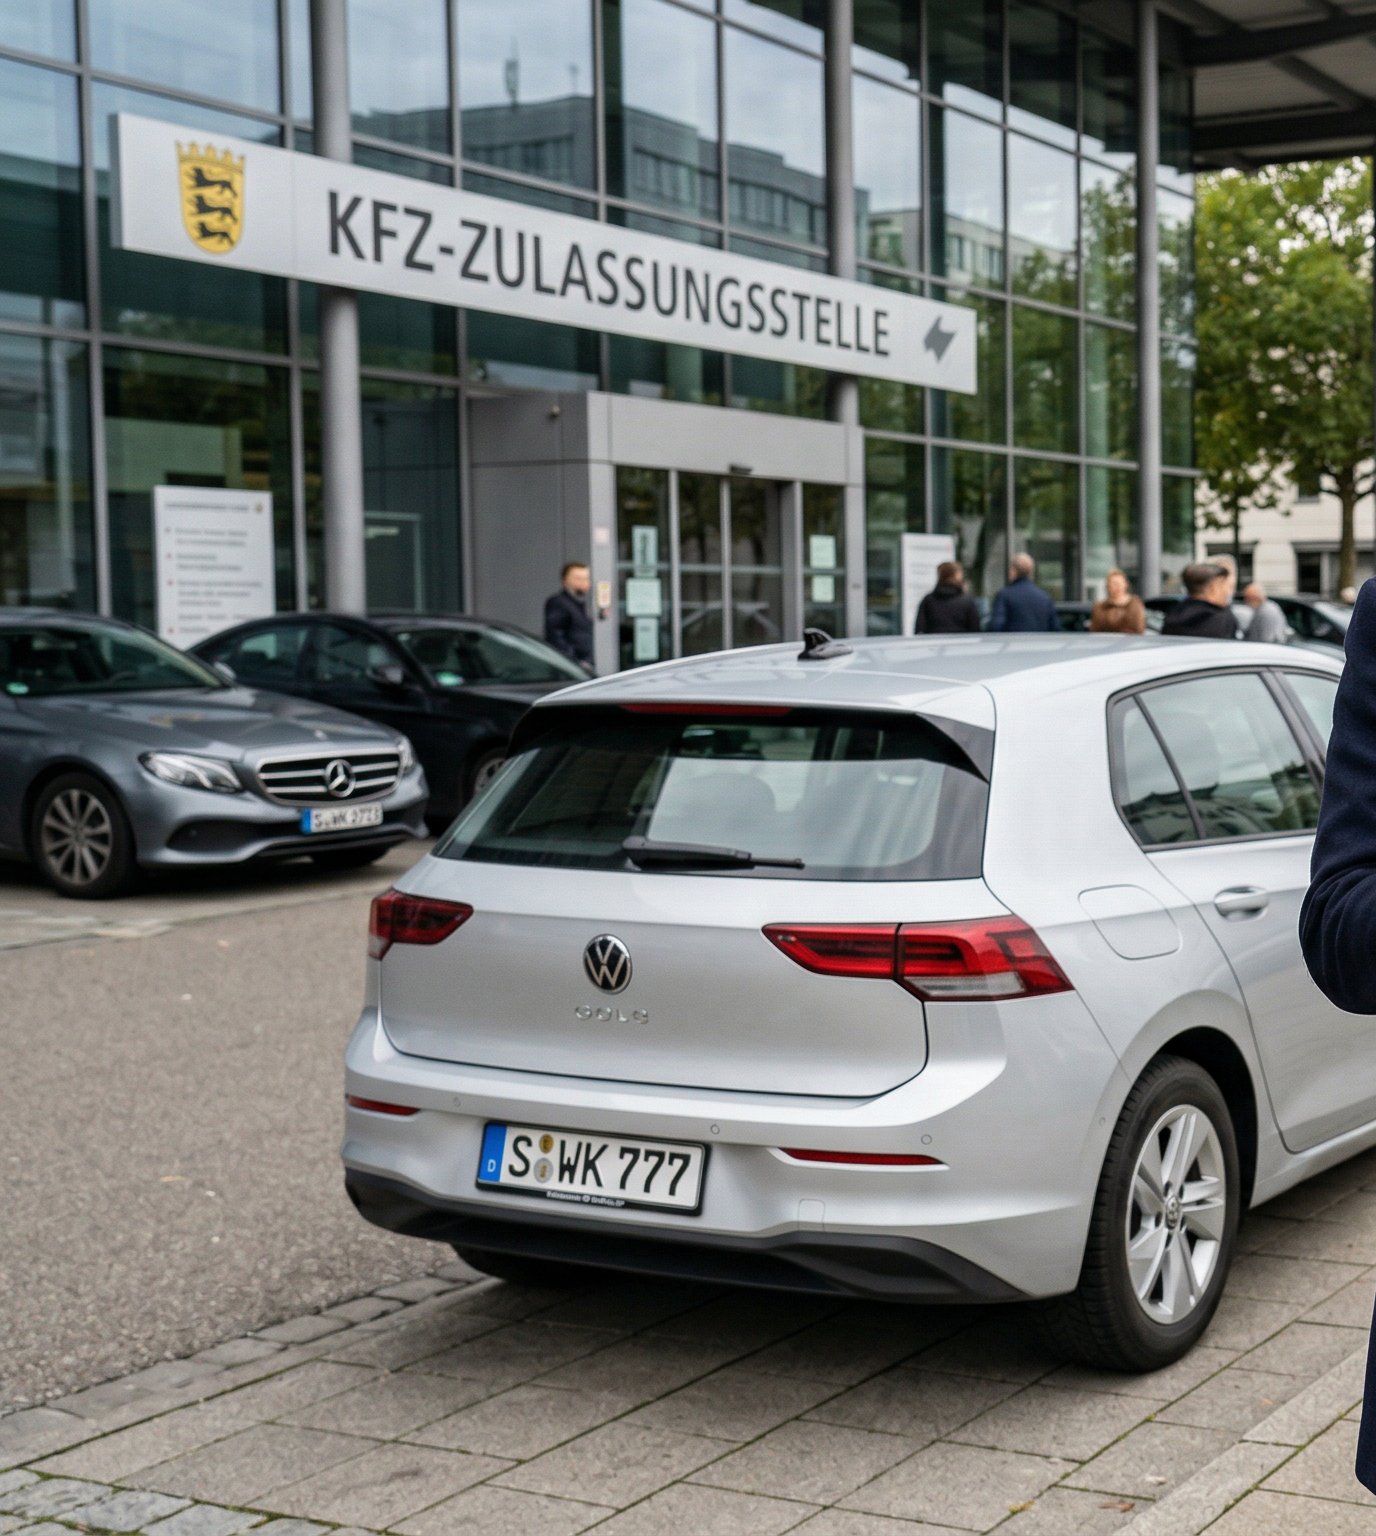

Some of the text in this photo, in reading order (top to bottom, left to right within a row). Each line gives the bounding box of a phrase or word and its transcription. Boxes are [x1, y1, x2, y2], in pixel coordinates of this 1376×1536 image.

[327, 190, 890, 357] KFZ-ZULASSUNGSSTELLE
[487, 1136, 691, 1196] D S WK 777
